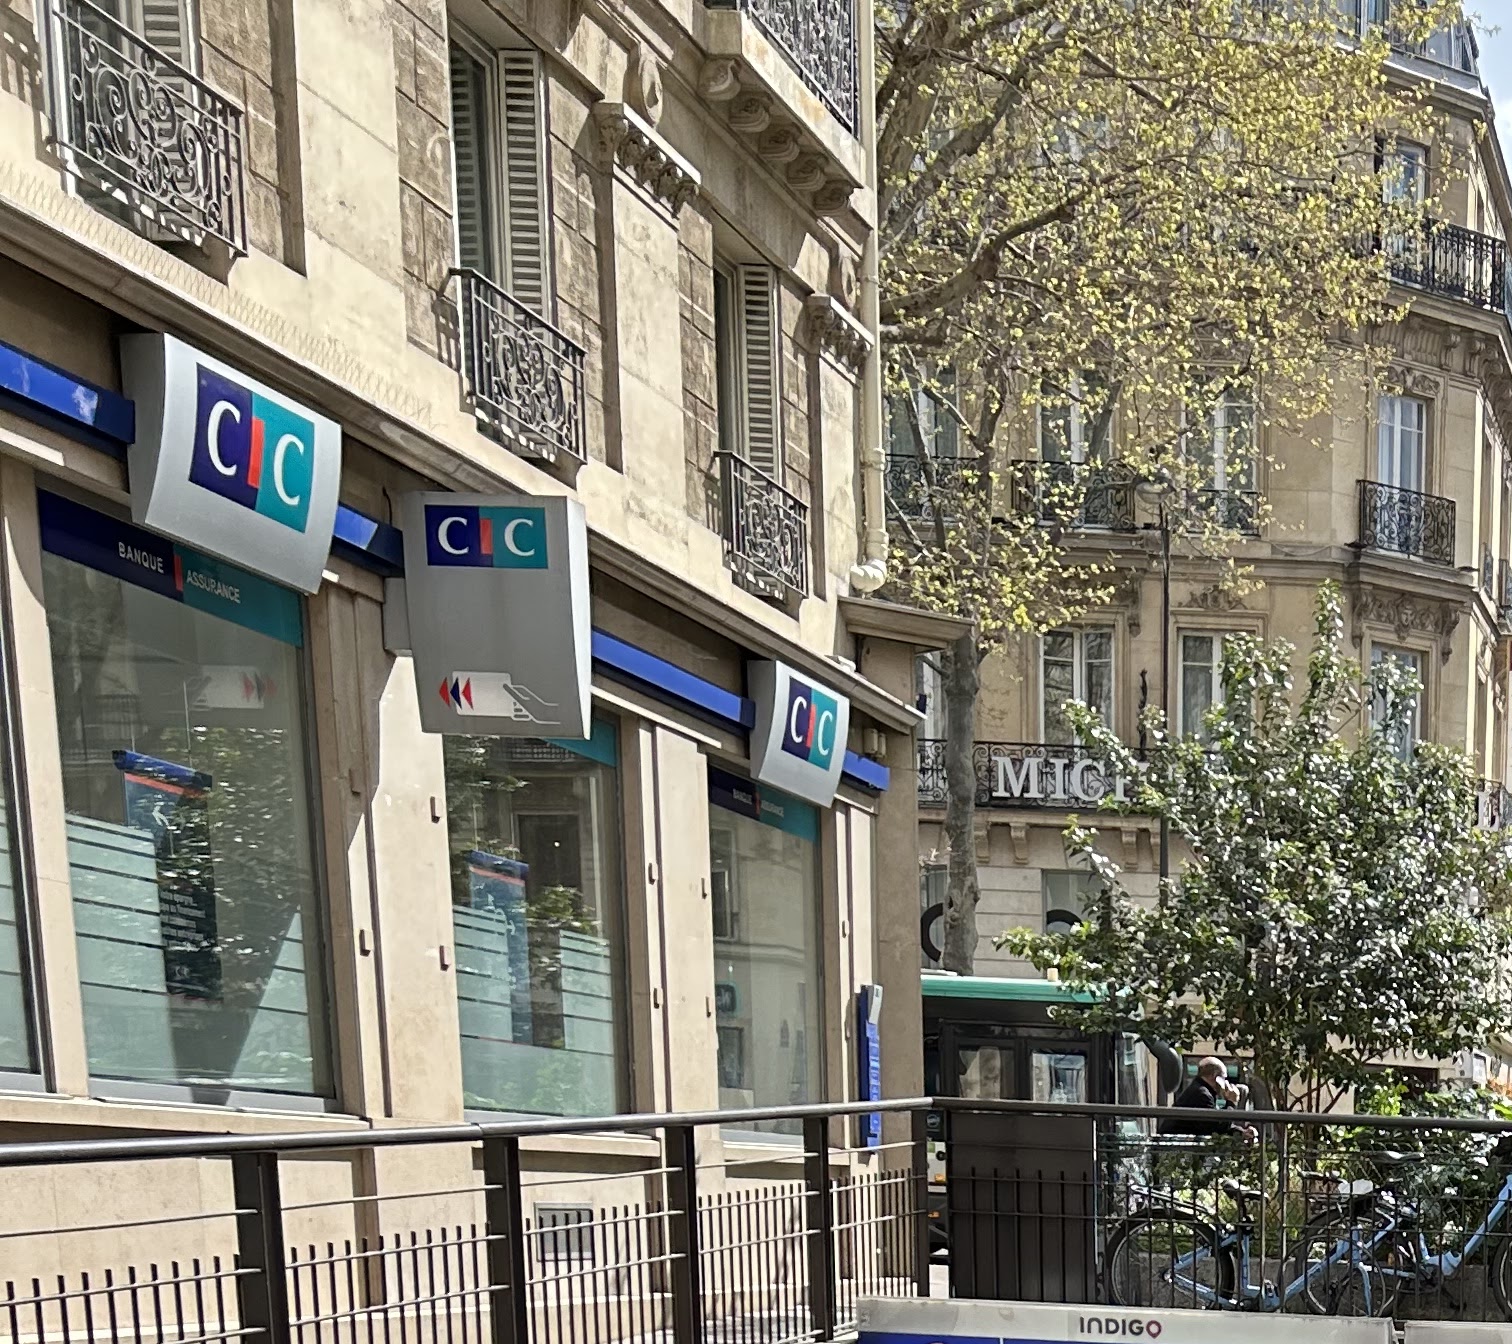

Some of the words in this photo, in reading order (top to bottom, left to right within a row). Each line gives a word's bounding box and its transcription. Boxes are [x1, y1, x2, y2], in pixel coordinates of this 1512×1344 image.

[208, 400, 304, 505] CIC
[438, 516, 535, 556] CIC
[118, 542, 164, 574] BANQUE
[186, 570, 241, 604] ASSURANCE
[791, 696, 833, 756] CIC
[1080, 1316, 1162, 1339] INDIGO
